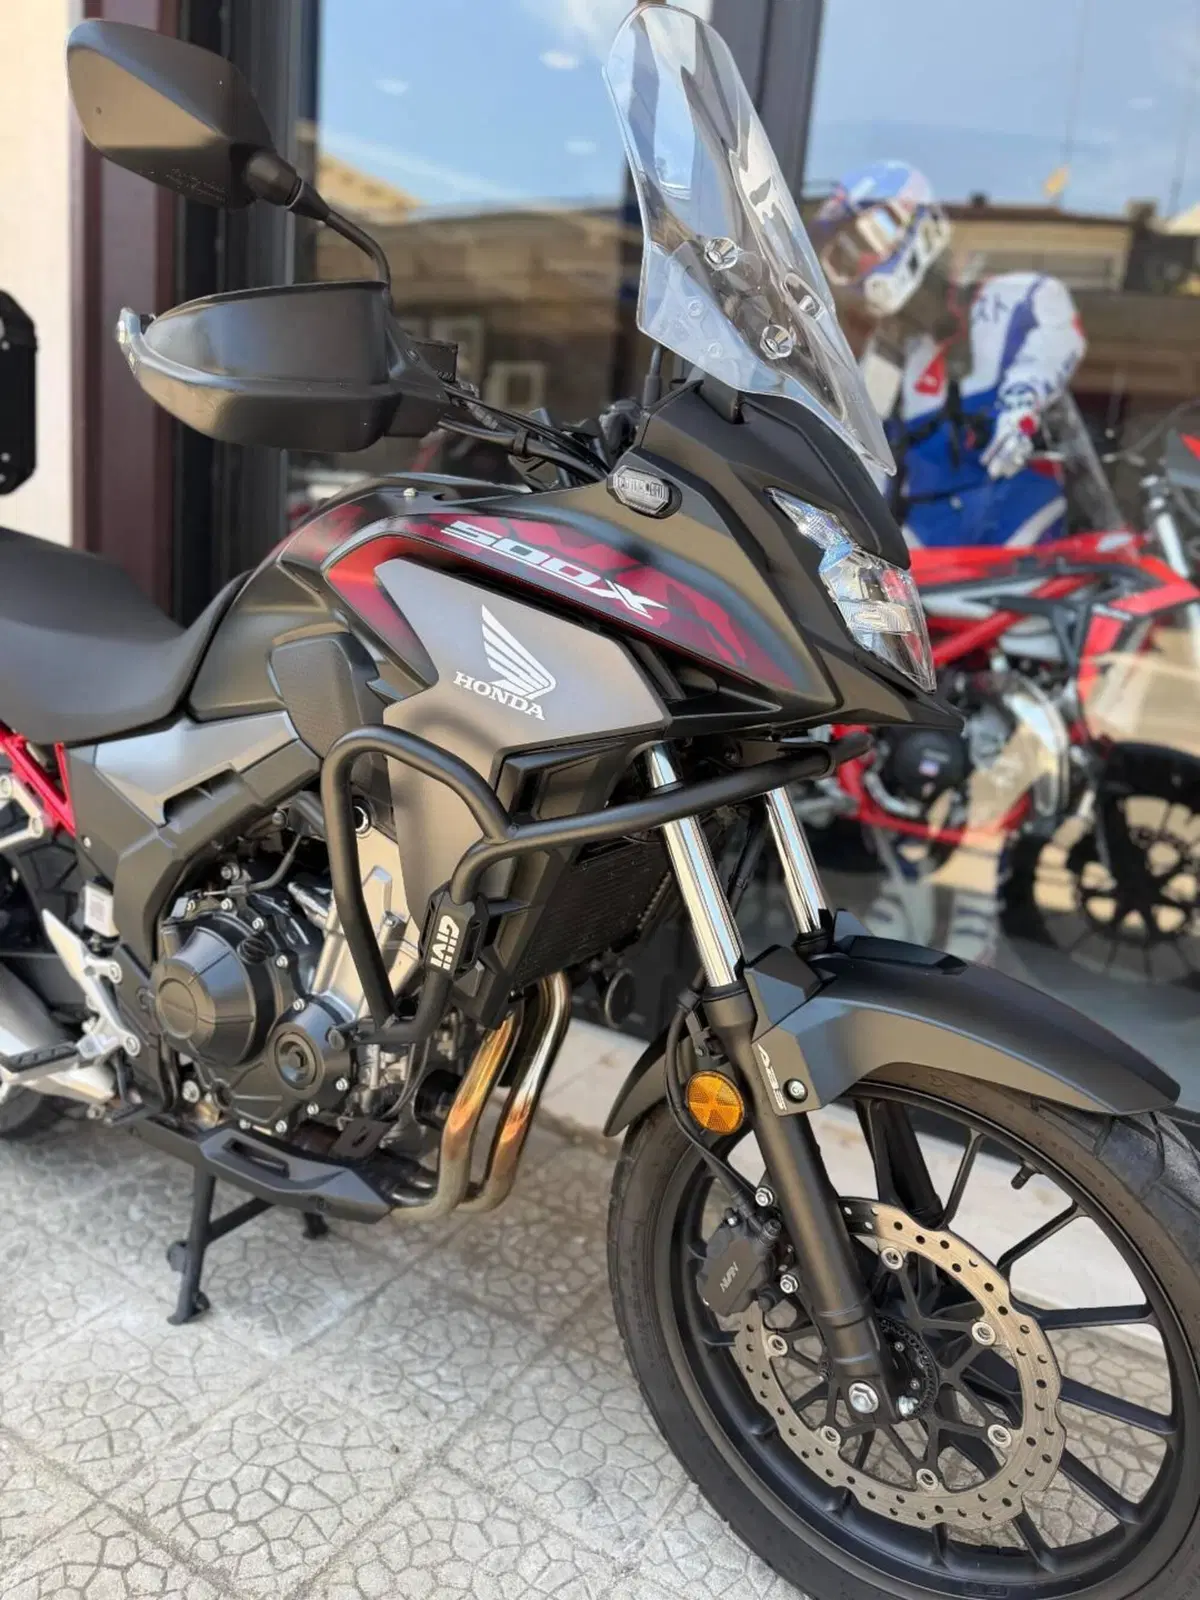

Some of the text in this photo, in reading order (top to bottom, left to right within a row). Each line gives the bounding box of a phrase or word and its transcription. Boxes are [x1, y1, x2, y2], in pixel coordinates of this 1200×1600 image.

[440, 520, 668, 620] 500X
[453, 671, 545, 720] HONDA
[430, 915, 460, 971] GIVI
